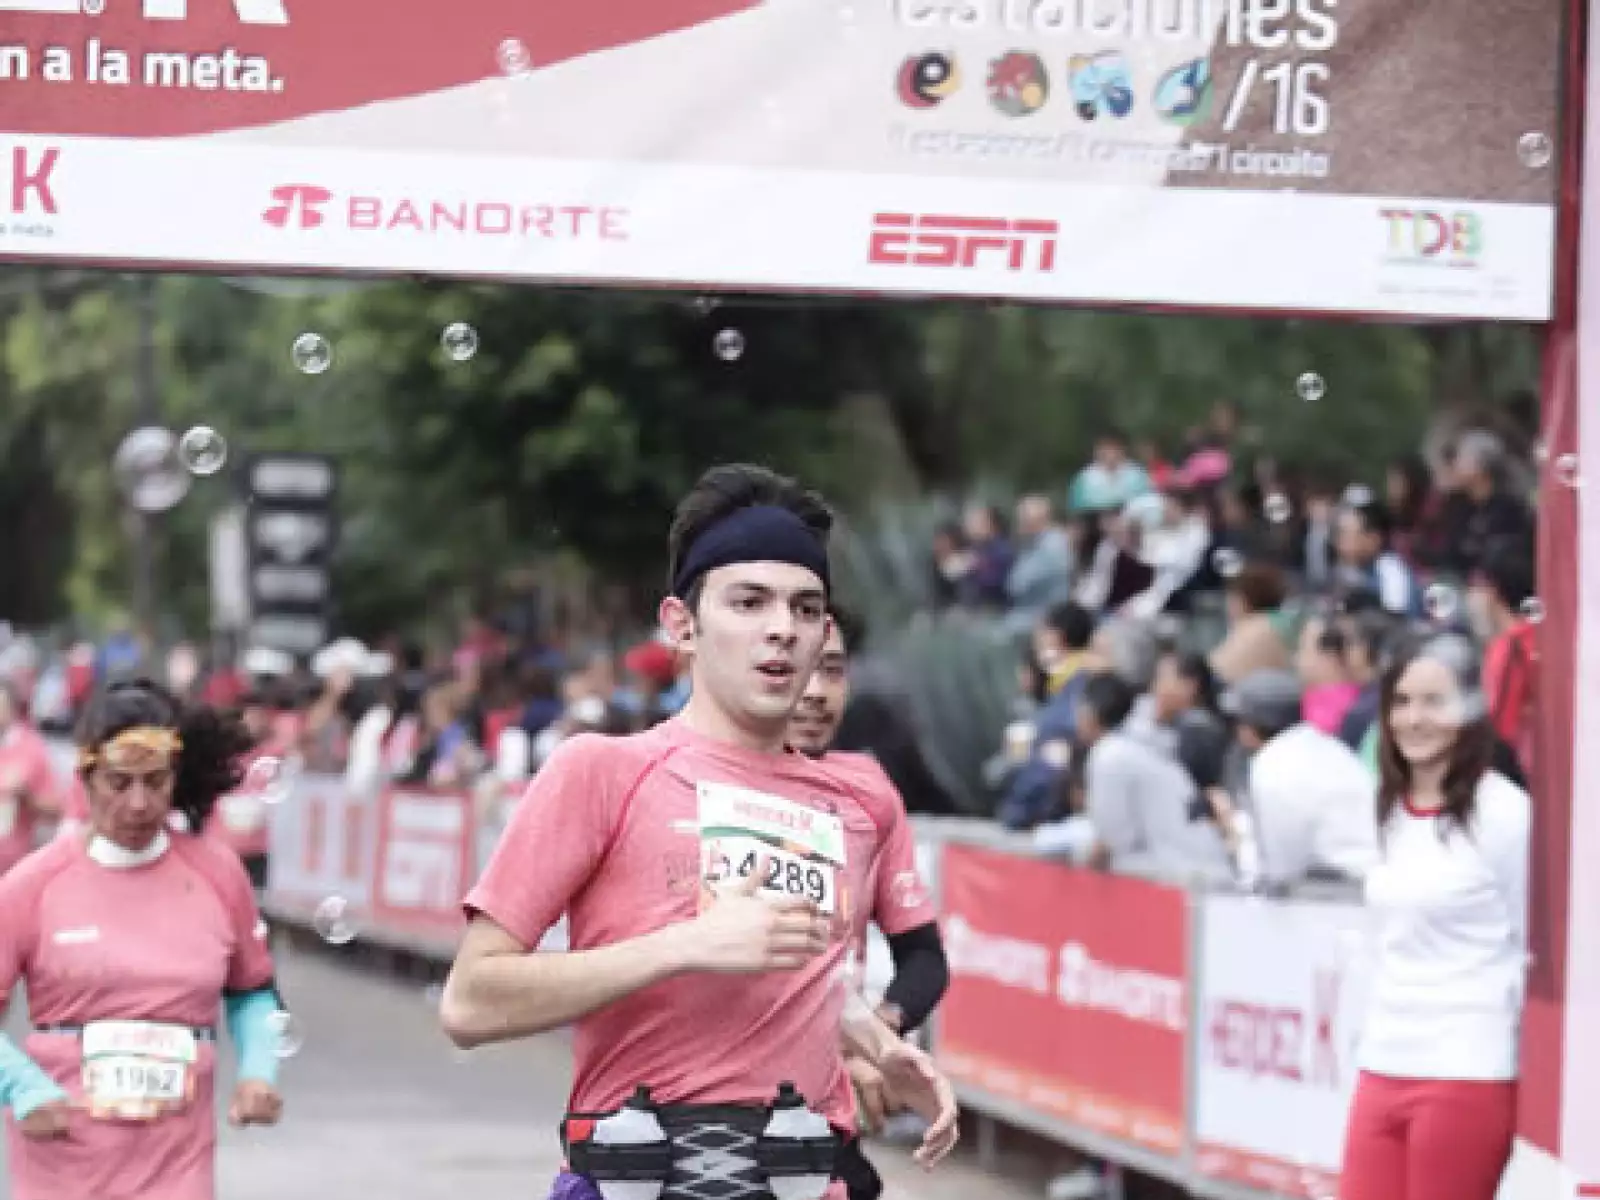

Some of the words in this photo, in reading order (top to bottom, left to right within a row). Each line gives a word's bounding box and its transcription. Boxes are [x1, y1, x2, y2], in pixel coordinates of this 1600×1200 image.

[42, 46, 73, 82] a
[86, 38, 130, 85] la
[144, 47, 285, 92] meta.
[1223, 59, 1330, 134] /16
[12, 146, 61, 214] K
[346, 196, 632, 240] BANORTE
[869, 213, 1060, 272] ESPN
